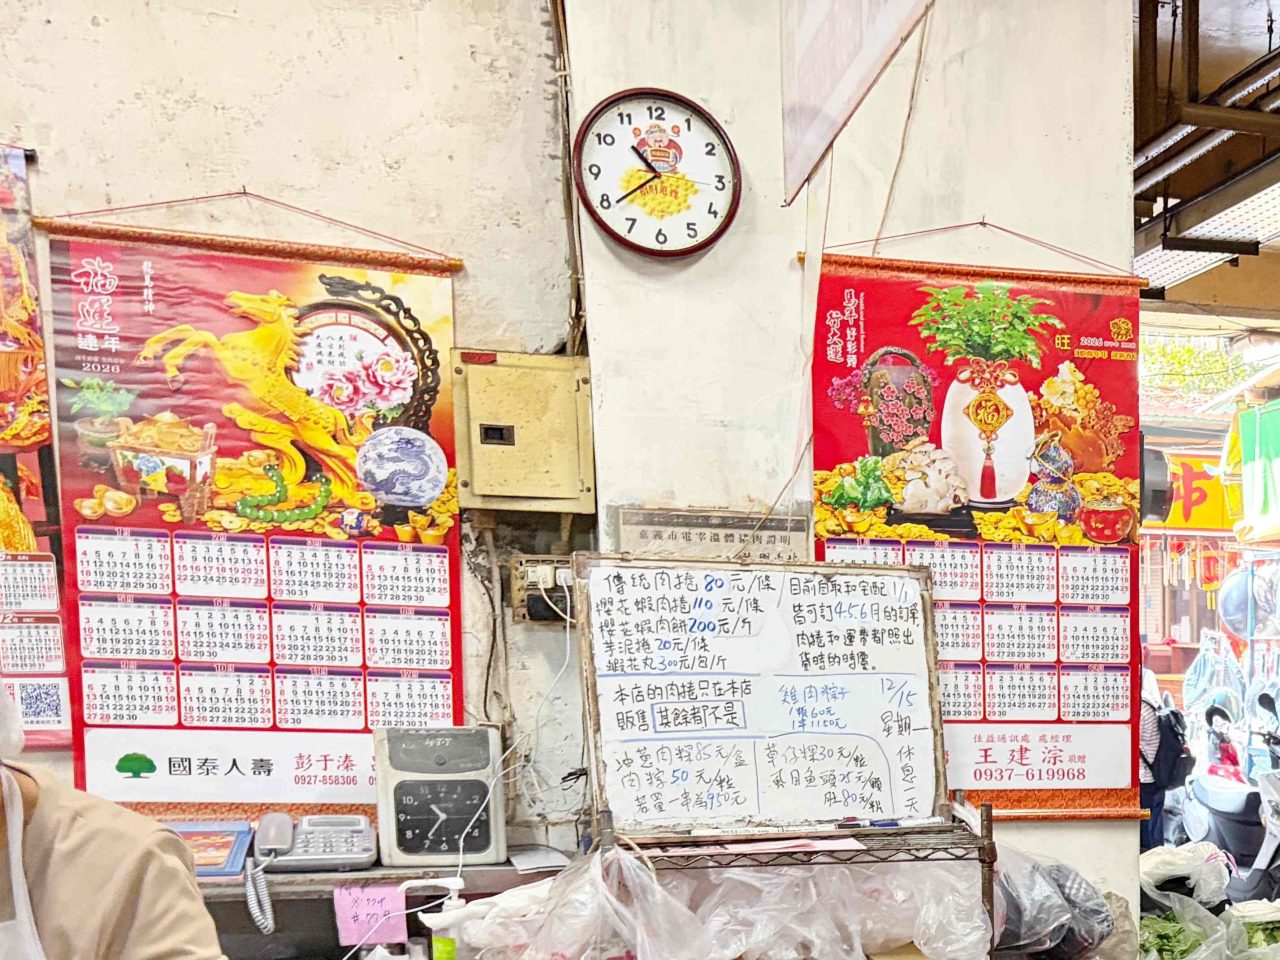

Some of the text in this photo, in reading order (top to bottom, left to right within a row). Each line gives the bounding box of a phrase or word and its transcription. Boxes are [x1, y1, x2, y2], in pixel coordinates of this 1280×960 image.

[618, 112, 632, 125] 11
[647, 106, 665, 121] 12
[685, 118, 691, 132] 1
[595, 133, 615, 146] 10
[705, 143, 716, 156] 2
[589, 164, 601, 180] 9
[715, 175, 726, 191] 3
[600, 194, 611, 209] 8
[708, 202, 718, 218] 4
[625, 218, 637, 233] 7
[686, 223, 698, 238] 5
[655, 228, 667, 245] 6
[1055, 334, 1071, 350] 旺
[82, 362, 120, 373] 2026
[974, 744, 1064, 767] 王建淙
[168, 757, 274, 776] 國泰人壽
[294, 753, 357, 772] 彭于溱
[294, 775, 358, 785] 0927-858306
[973, 768, 1086, 781] 0937-619968
[402, 796, 413, 805] 10
[472, 796, 480, 804] 2
[399, 814, 405, 822] 9
[480, 812, 488, 820] 3
[405, 830, 413, 839] 8
[472, 829, 479, 837] 4
[424, 840, 430, 849] 7
